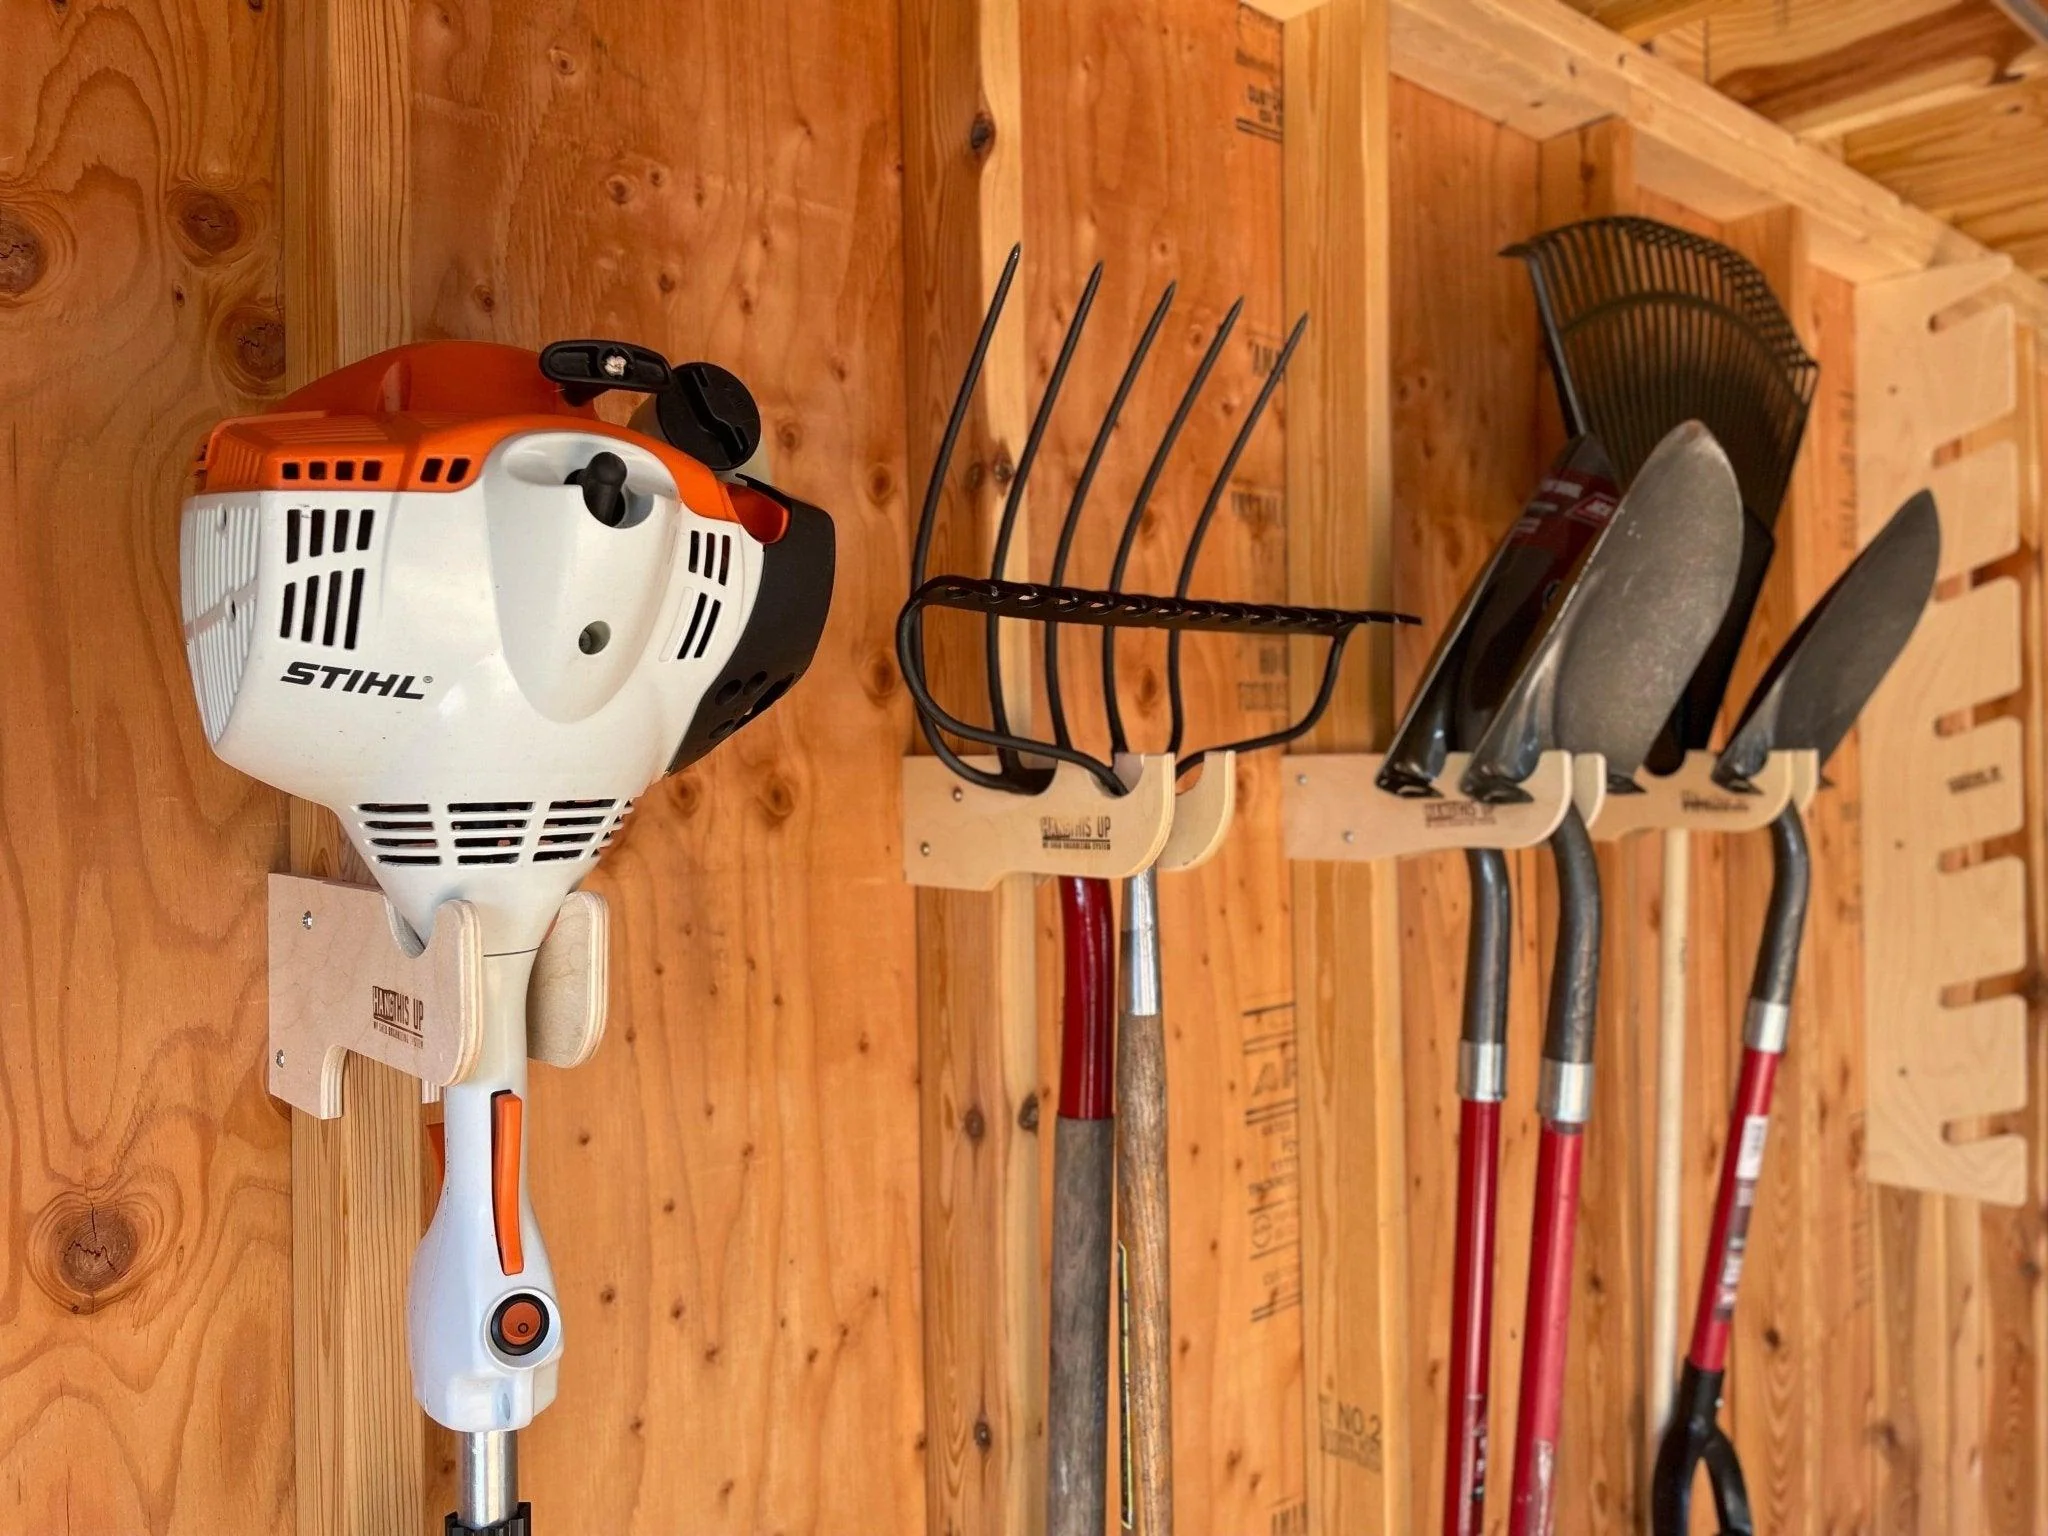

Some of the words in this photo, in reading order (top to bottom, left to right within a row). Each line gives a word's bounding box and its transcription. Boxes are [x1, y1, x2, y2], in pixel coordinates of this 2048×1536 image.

[280, 661, 426, 700] STIHL
[1097, 816, 1111, 838] UP
[393, 992, 410, 1026] THIS
[413, 998, 424, 1031] UP
